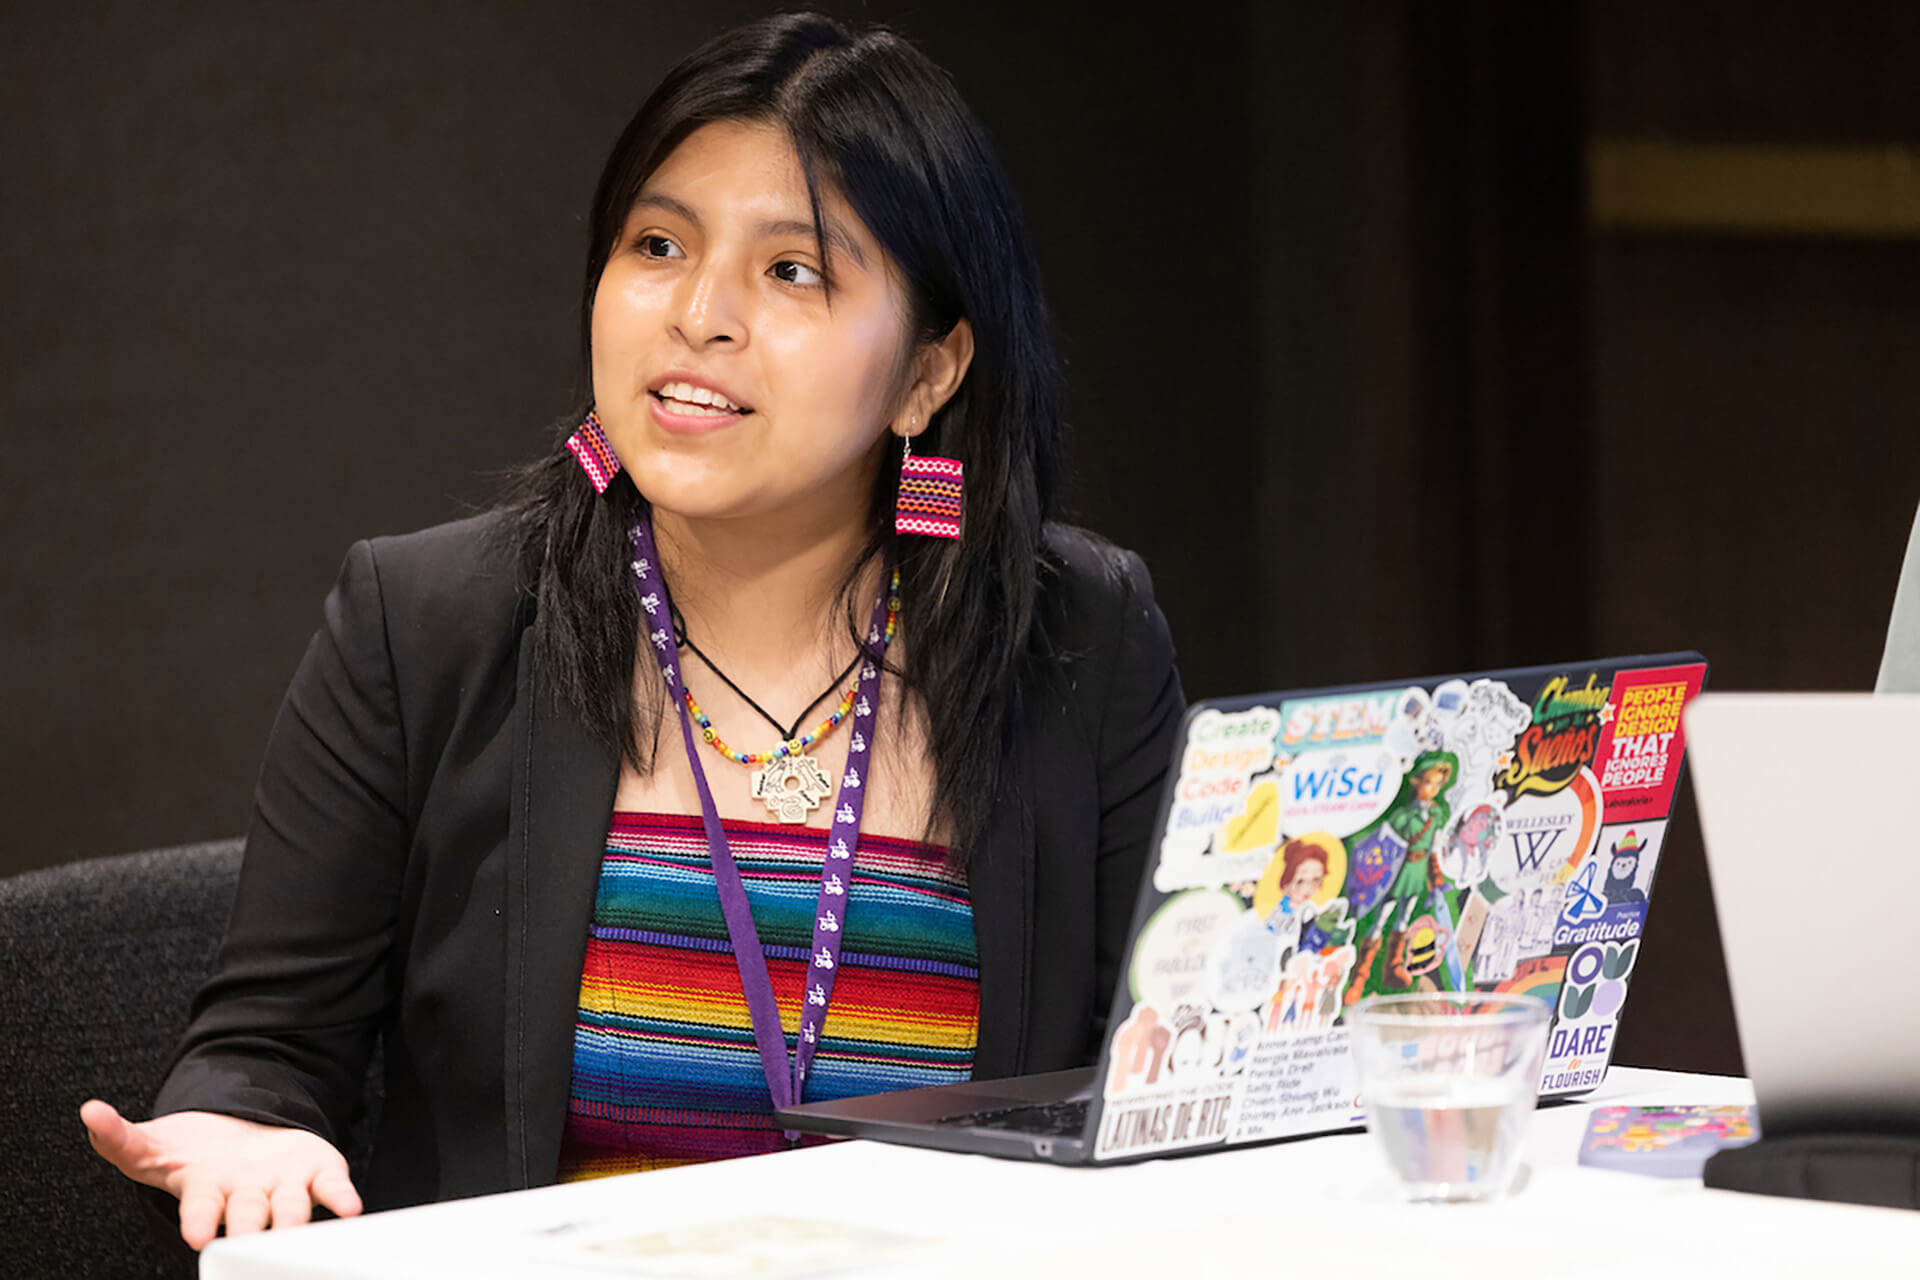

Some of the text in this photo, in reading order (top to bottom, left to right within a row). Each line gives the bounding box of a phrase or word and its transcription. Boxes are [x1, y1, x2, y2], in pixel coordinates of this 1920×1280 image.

[1622, 685, 1687, 706] PEOPLE
[1618, 701, 1683, 722] IGNORE
[1197, 718, 1272, 742] Create
[1614, 717, 1679, 738] DESIGN
[1504, 724, 1598, 786] Sueños
[1612, 732, 1675, 758] THAT
[1189, 746, 1268, 771] Design
[1605, 753, 1669, 772] IGNORES
[1294, 766, 1384, 801] WiSci
[1601, 766, 1666, 787] PEOPLE
[1182, 777, 1243, 800] Code
[1505, 814, 1574, 830] WELLESLEY
[1509, 827, 1567, 872] W
[1554, 920, 1640, 945] Gratitude
[1550, 1024, 1612, 1059] DARE
[1541, 1069, 1601, 1090] FLOURISH
